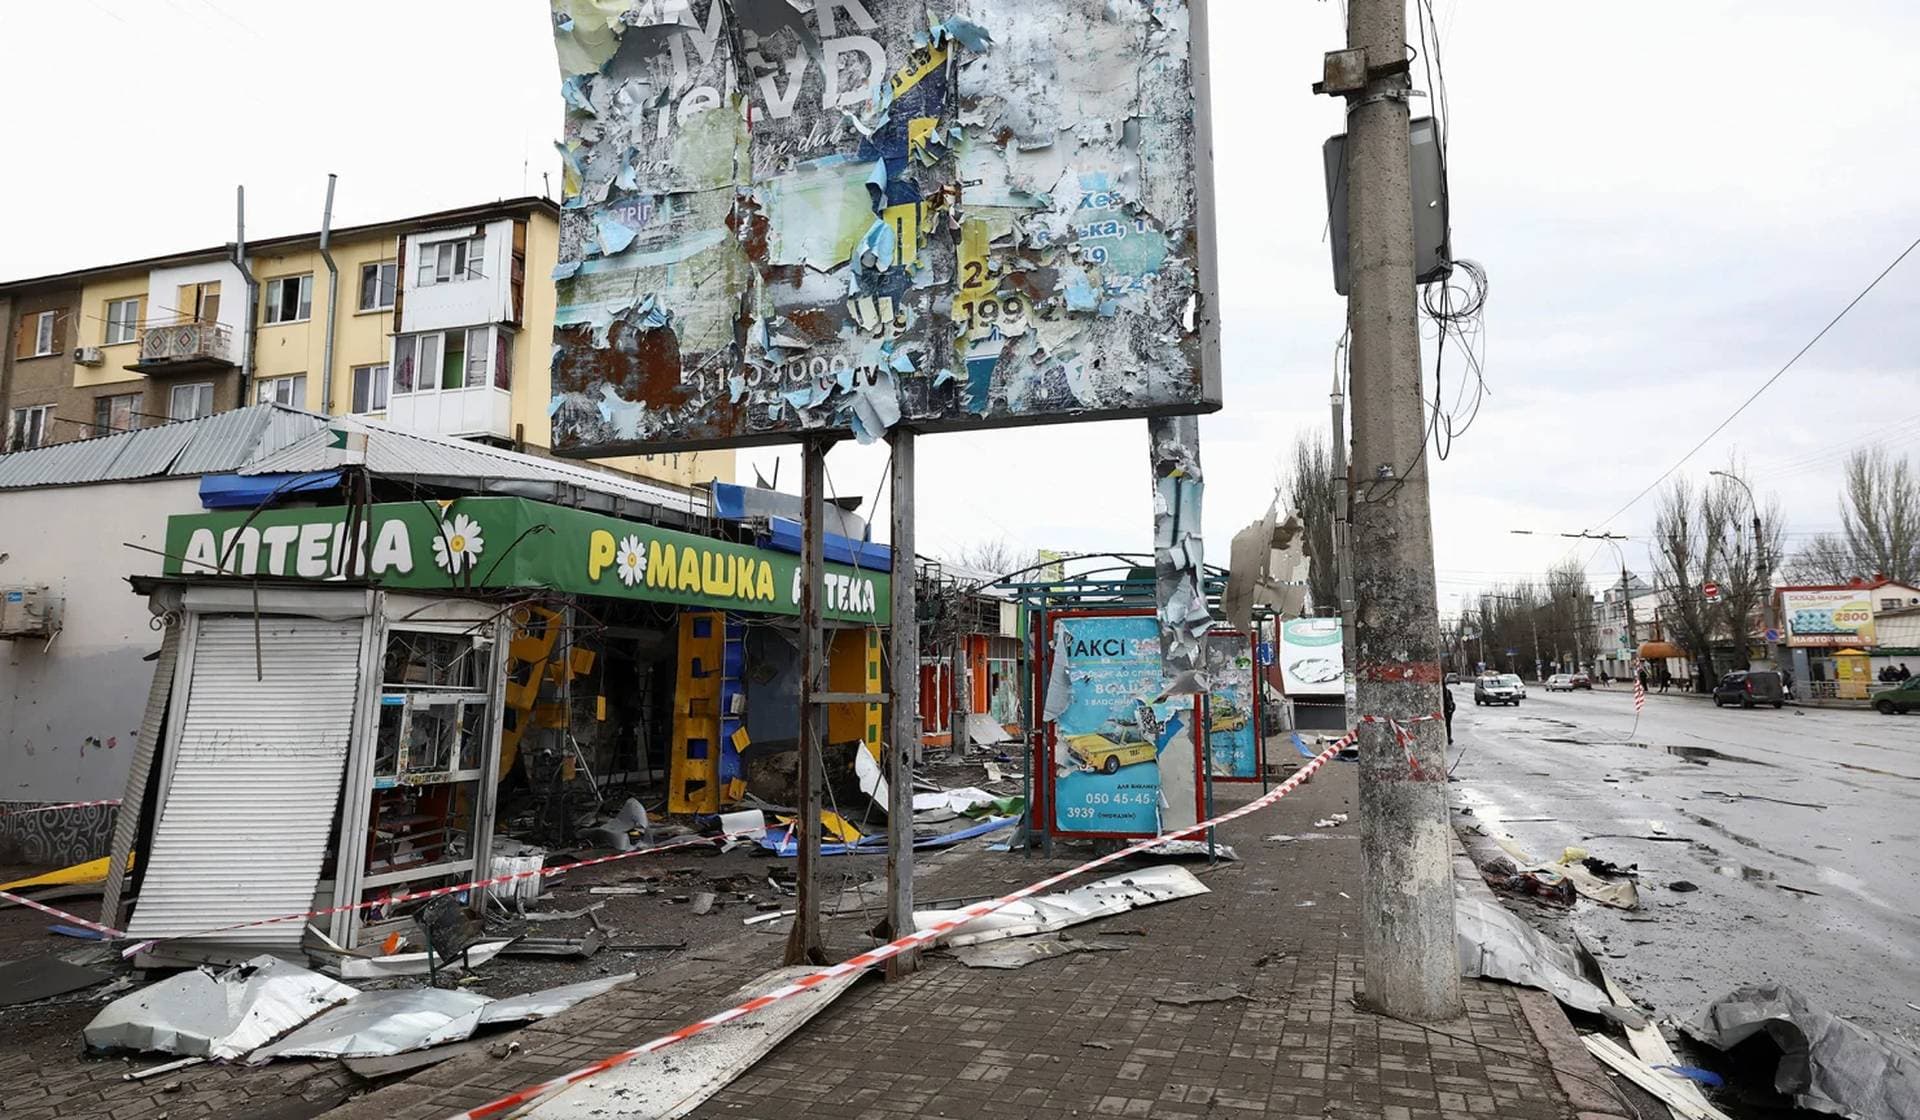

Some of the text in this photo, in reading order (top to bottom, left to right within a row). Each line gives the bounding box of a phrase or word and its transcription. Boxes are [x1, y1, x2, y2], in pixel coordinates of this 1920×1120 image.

[182, 519, 412, 578] АПТЕКА
[792, 565, 876, 614] АТЕКА
[1834, 612, 1869, 623] 2800
[1085, 792, 1110, 805] 050
[1067, 807, 1095, 819] 3939
